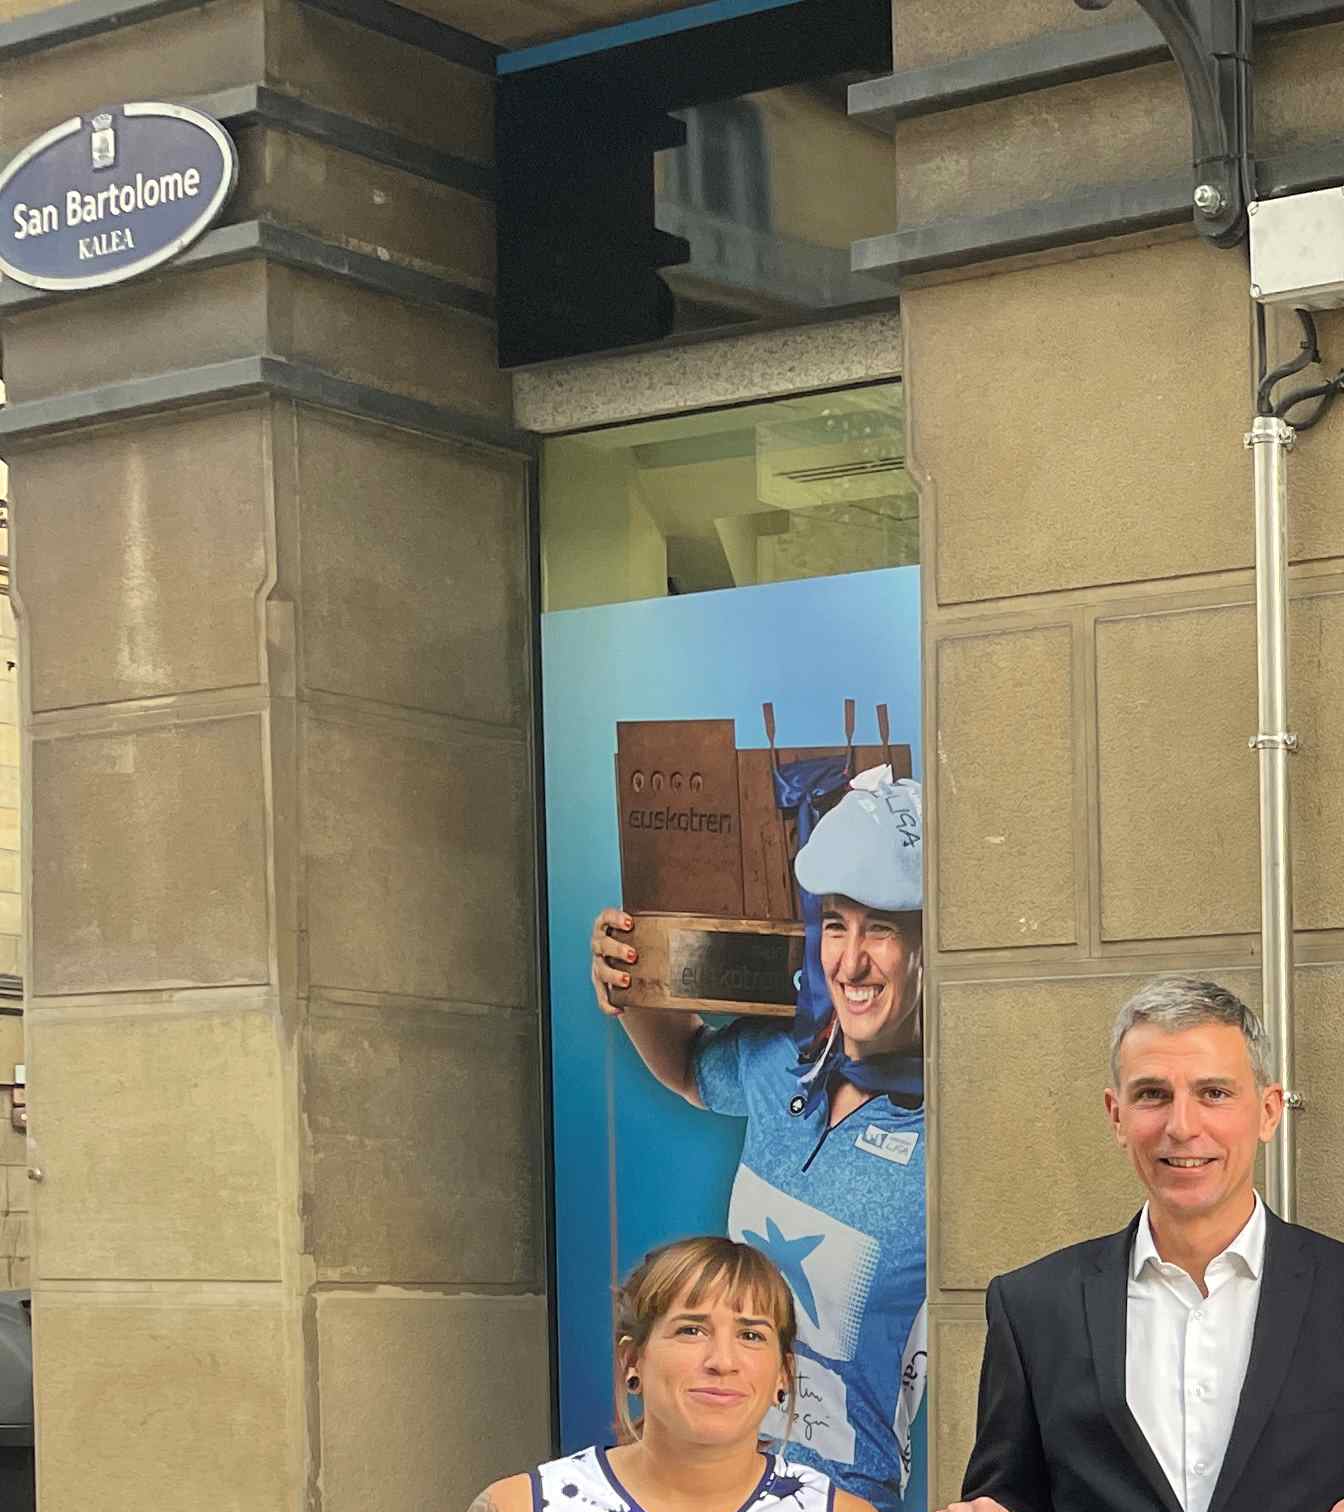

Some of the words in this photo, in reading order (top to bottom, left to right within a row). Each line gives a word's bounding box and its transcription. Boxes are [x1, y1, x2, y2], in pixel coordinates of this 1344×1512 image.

[13, 203, 58, 239] San
[66, 168, 200, 226] Bartolome
[79, 228, 134, 259] KALEA
[629, 806, 732, 834] euskotren
